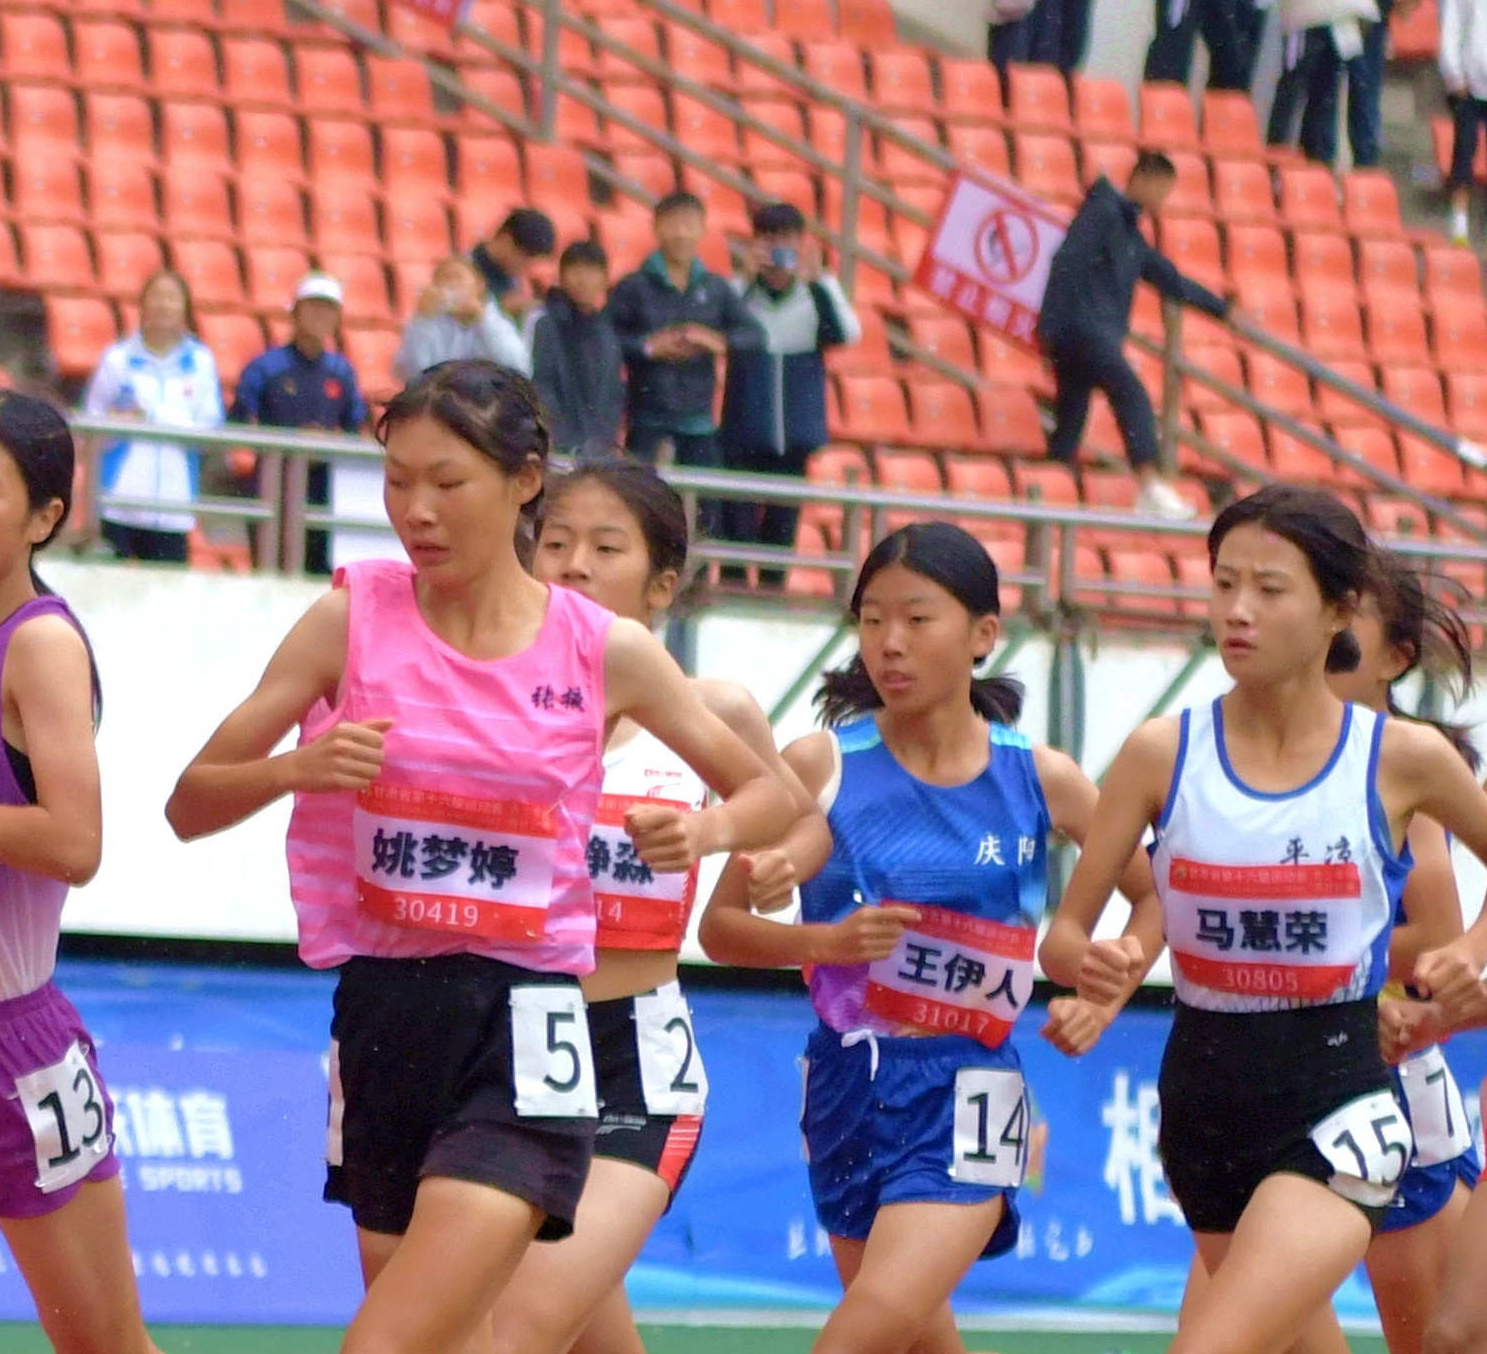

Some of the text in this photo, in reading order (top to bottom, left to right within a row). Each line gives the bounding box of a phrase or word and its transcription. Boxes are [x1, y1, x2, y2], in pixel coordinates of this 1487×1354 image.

[372, 828, 519, 890] 姚梦婷
[393, 898, 479, 927] 30419
[1196, 908, 1328, 955] 马慧荣
[898, 942, 1019, 1009] 王伊人
[1222, 968, 1299, 991] 30805
[545, 1011, 580, 1092] 5
[914, 1003, 990, 1034] 31017
[664, 1016, 700, 1094] 2
[37, 1068, 103, 1168] 13
[963, 1092, 1024, 1166] 14
[1333, 1115, 1406, 1185] 15
